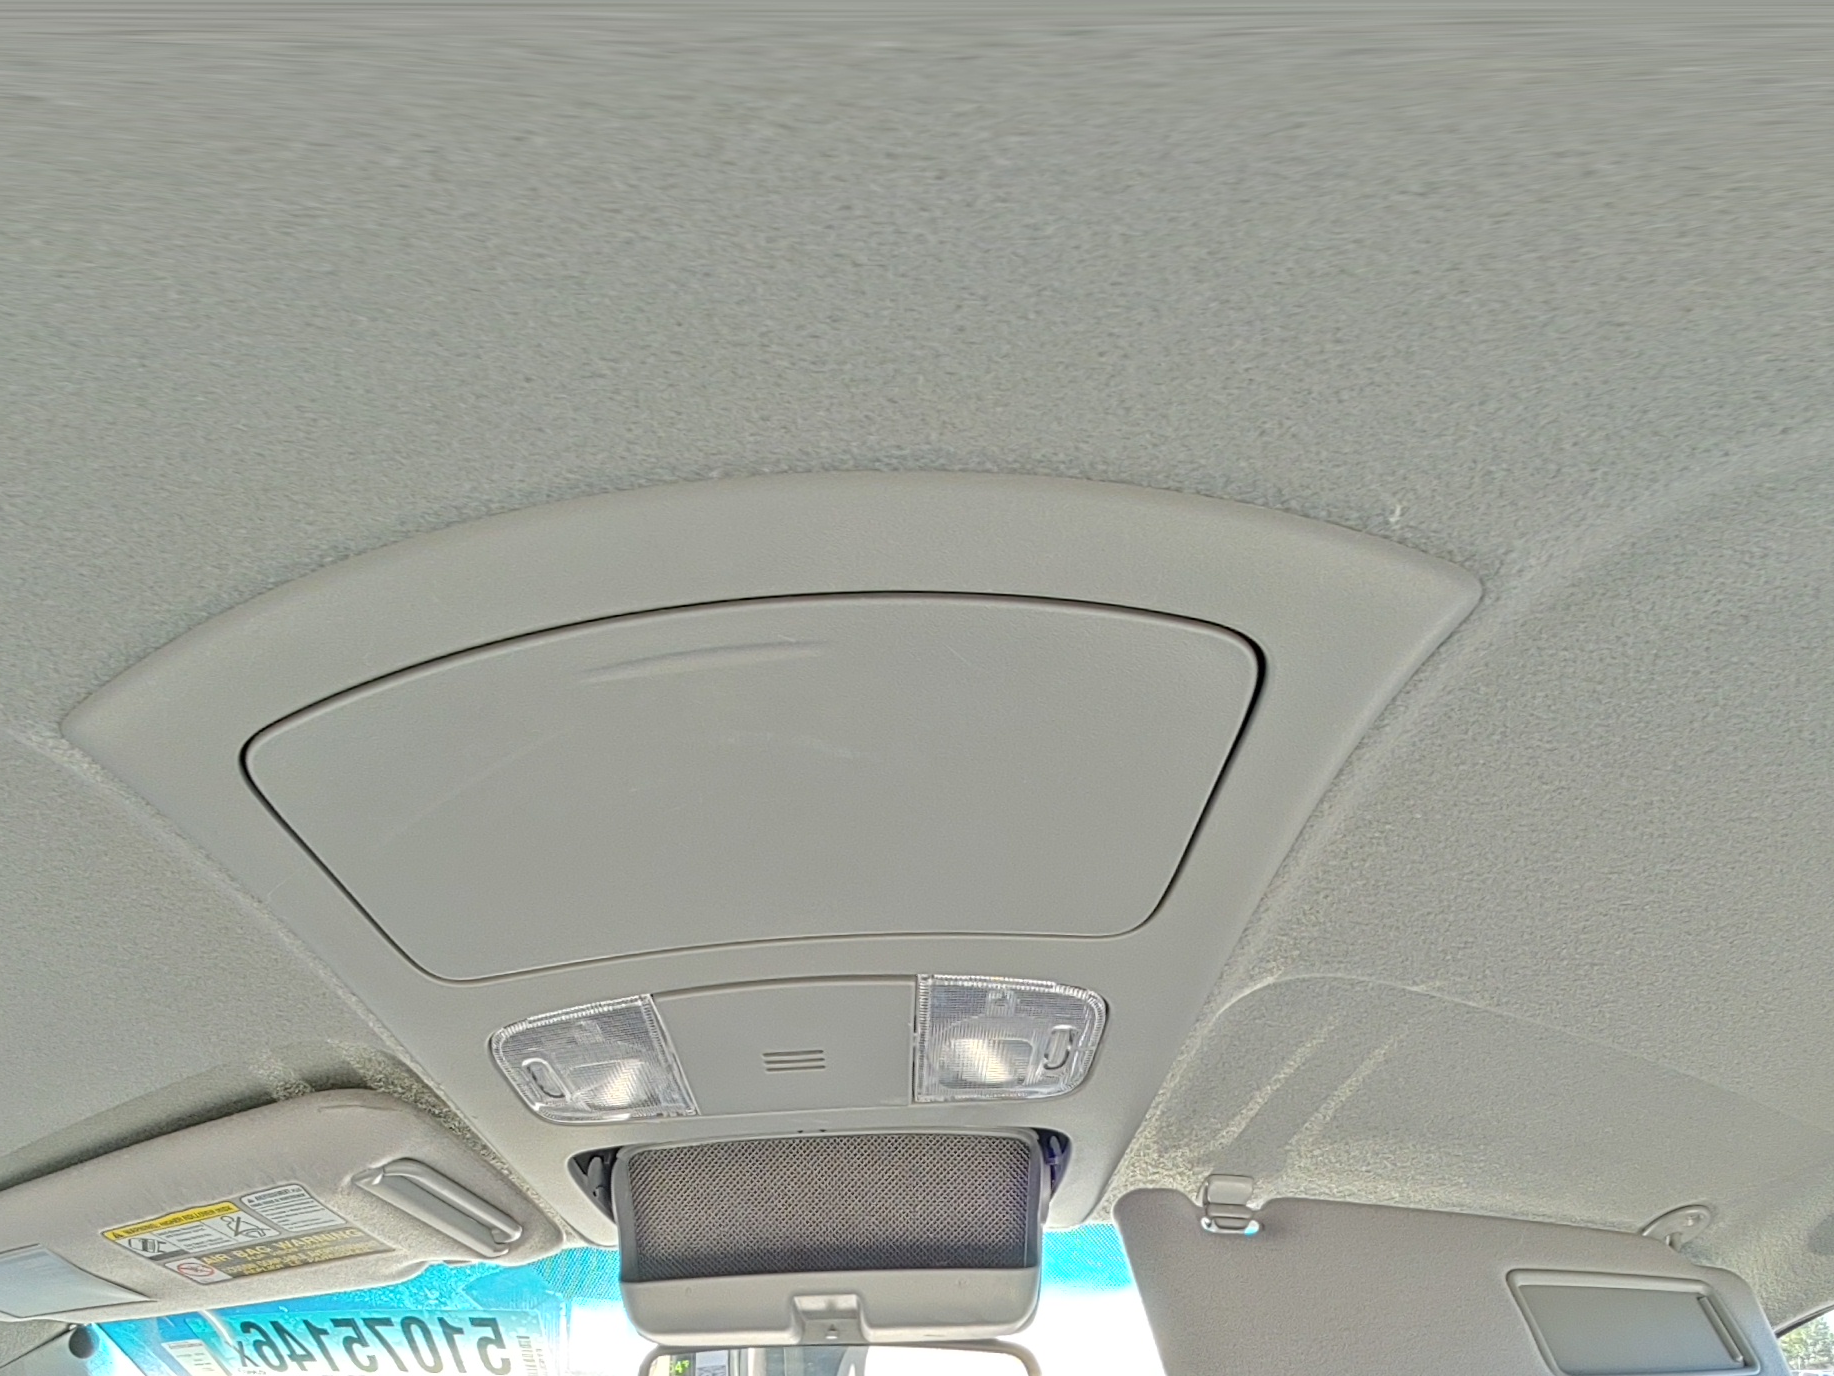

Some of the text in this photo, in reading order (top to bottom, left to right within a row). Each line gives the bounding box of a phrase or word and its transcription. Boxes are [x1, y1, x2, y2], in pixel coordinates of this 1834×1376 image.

[202, 1253, 231, 1265] AIR
[235, 1245, 271, 1258] BAG
[273, 1228, 364, 1250] WARNING
